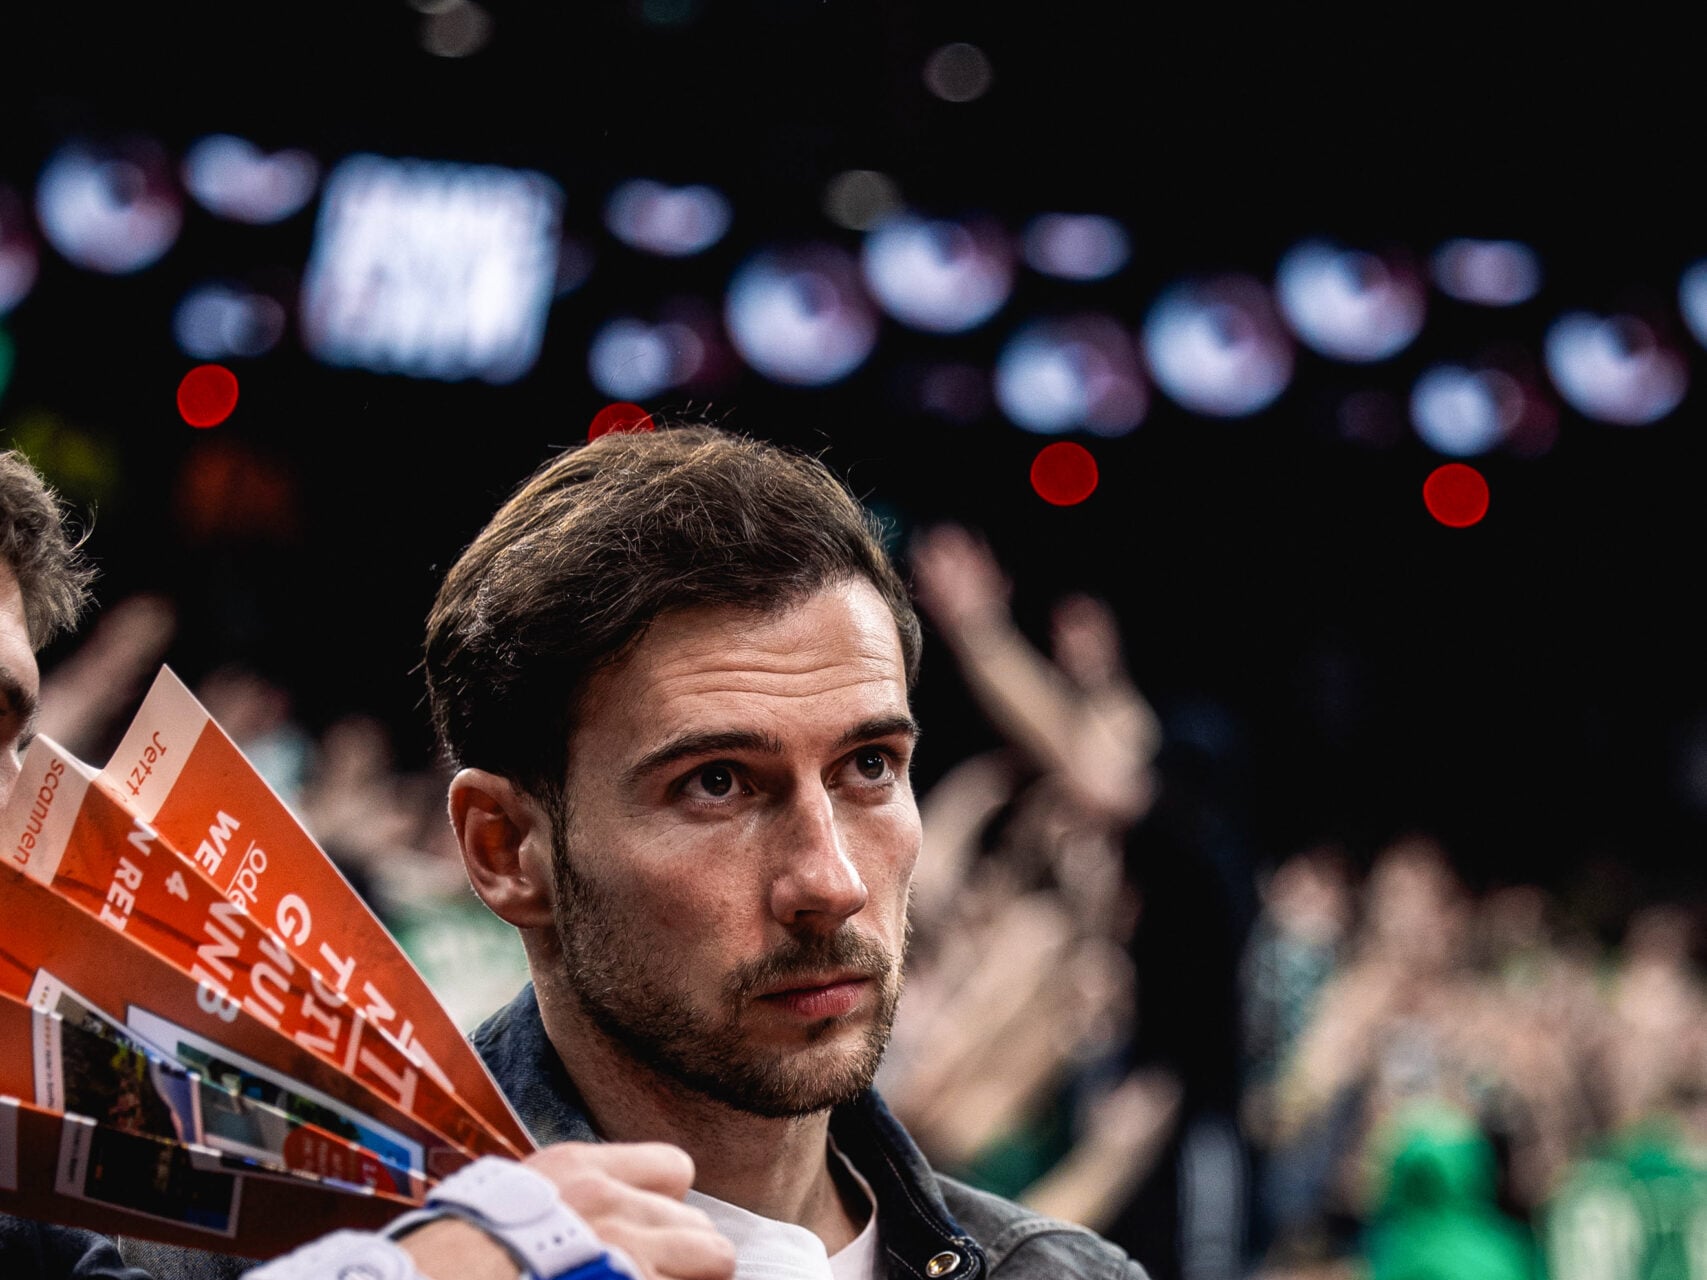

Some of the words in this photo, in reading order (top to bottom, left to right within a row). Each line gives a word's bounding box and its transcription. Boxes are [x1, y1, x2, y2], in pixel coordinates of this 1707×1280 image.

[125, 731, 167, 796] Jetzt
[13, 759, 65, 865] scannen
[165, 871, 189, 901] 4
[276, 893, 311, 946] G
